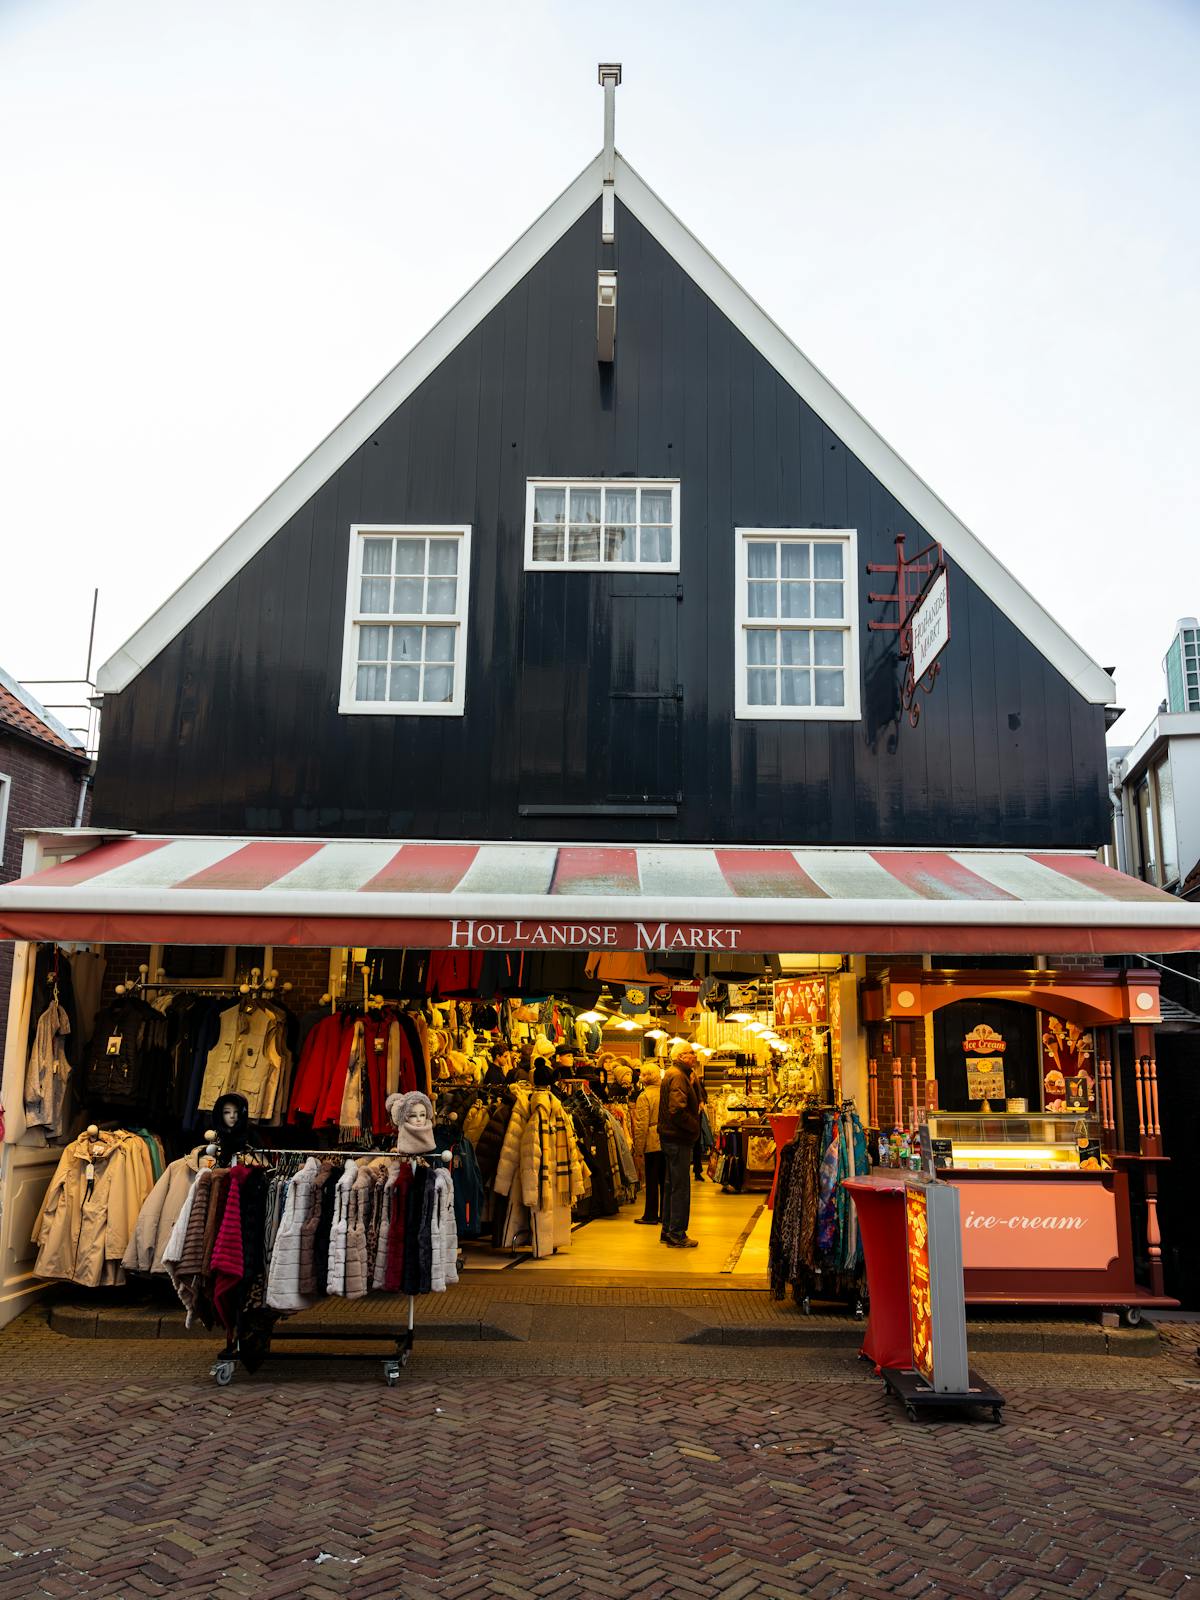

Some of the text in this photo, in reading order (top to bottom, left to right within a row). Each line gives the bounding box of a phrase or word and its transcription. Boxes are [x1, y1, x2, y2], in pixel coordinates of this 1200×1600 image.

[914, 587, 946, 649] HOLLANDSE
[920, 617, 941, 663] MARKT
[448, 920, 742, 951] HOLLANDSE MARKT
[964, 1040, 1006, 1049] Ice Cream
[965, 1210, 1089, 1230] ice-cream
